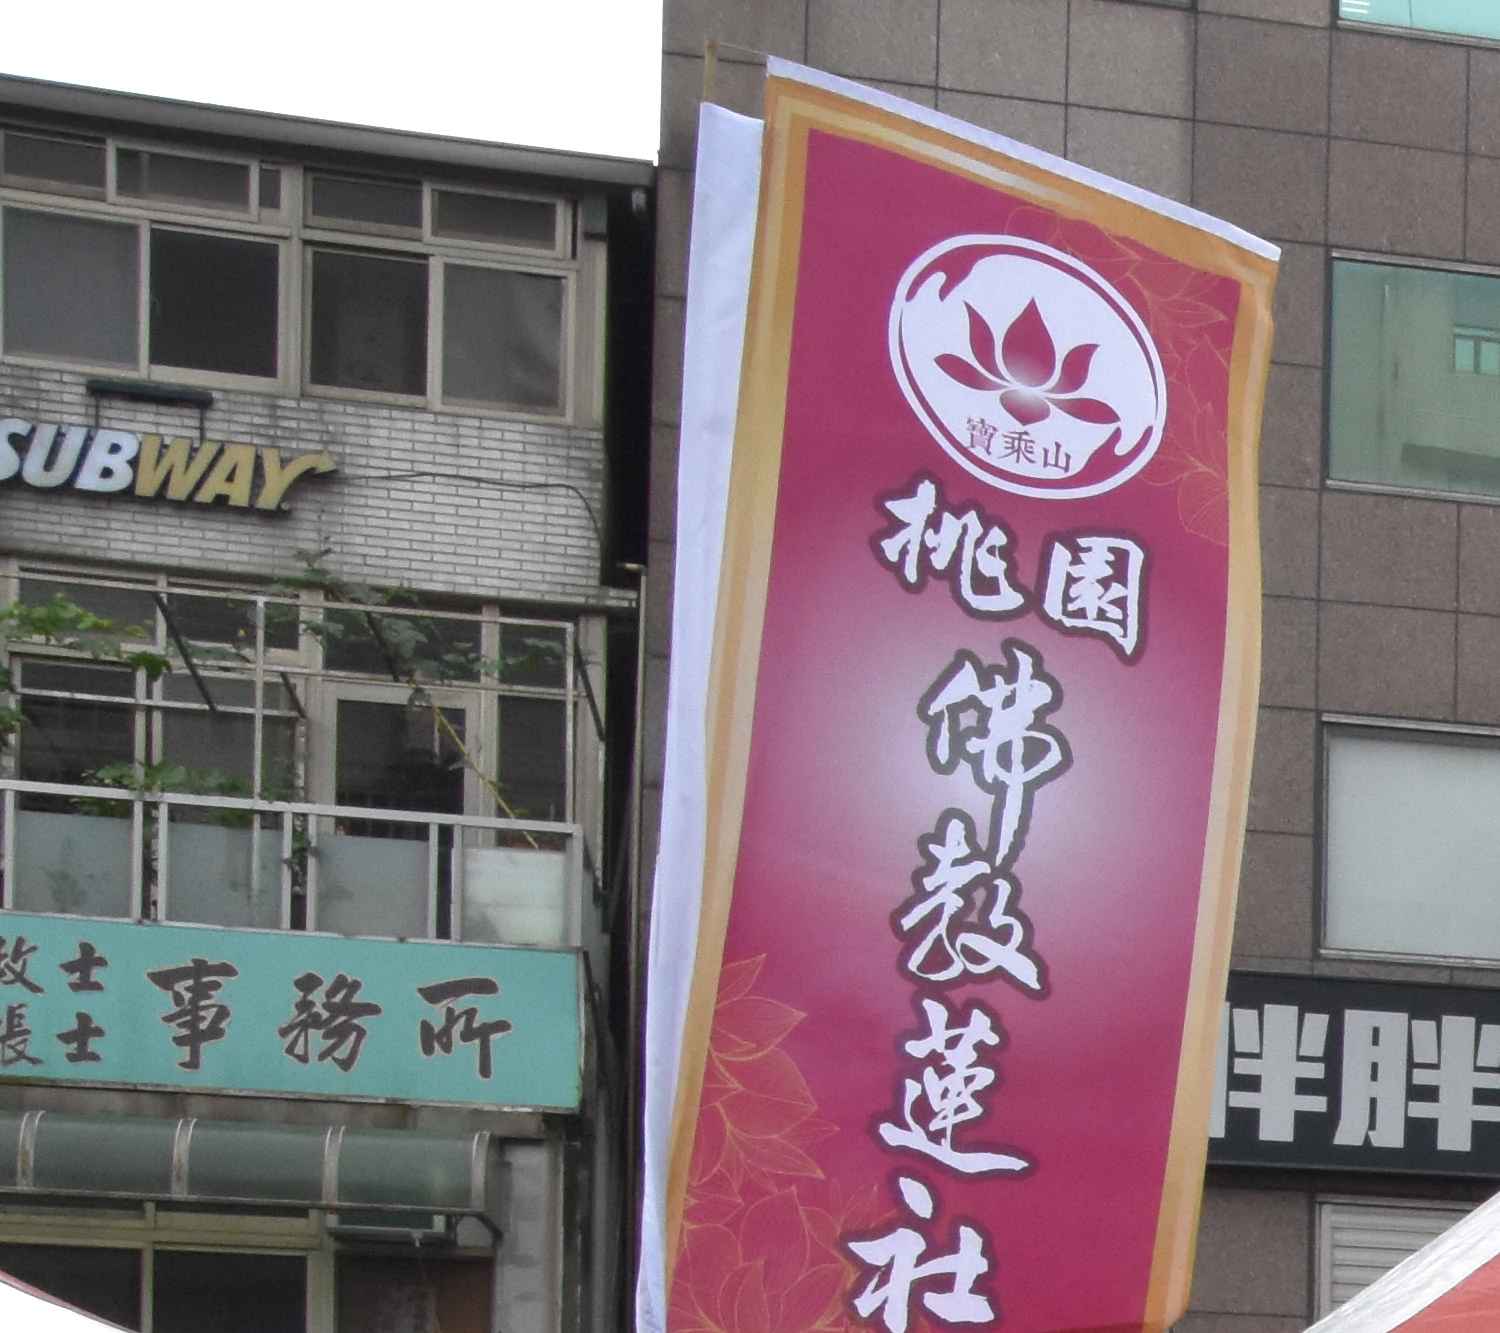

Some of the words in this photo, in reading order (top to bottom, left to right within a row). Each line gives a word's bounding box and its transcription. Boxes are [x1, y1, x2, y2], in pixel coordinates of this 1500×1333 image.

[0, 418, 337, 511] SUBWAY
[963, 416, 1073, 474] 寶乘山
[146, 957, 512, 1080] 事務所
